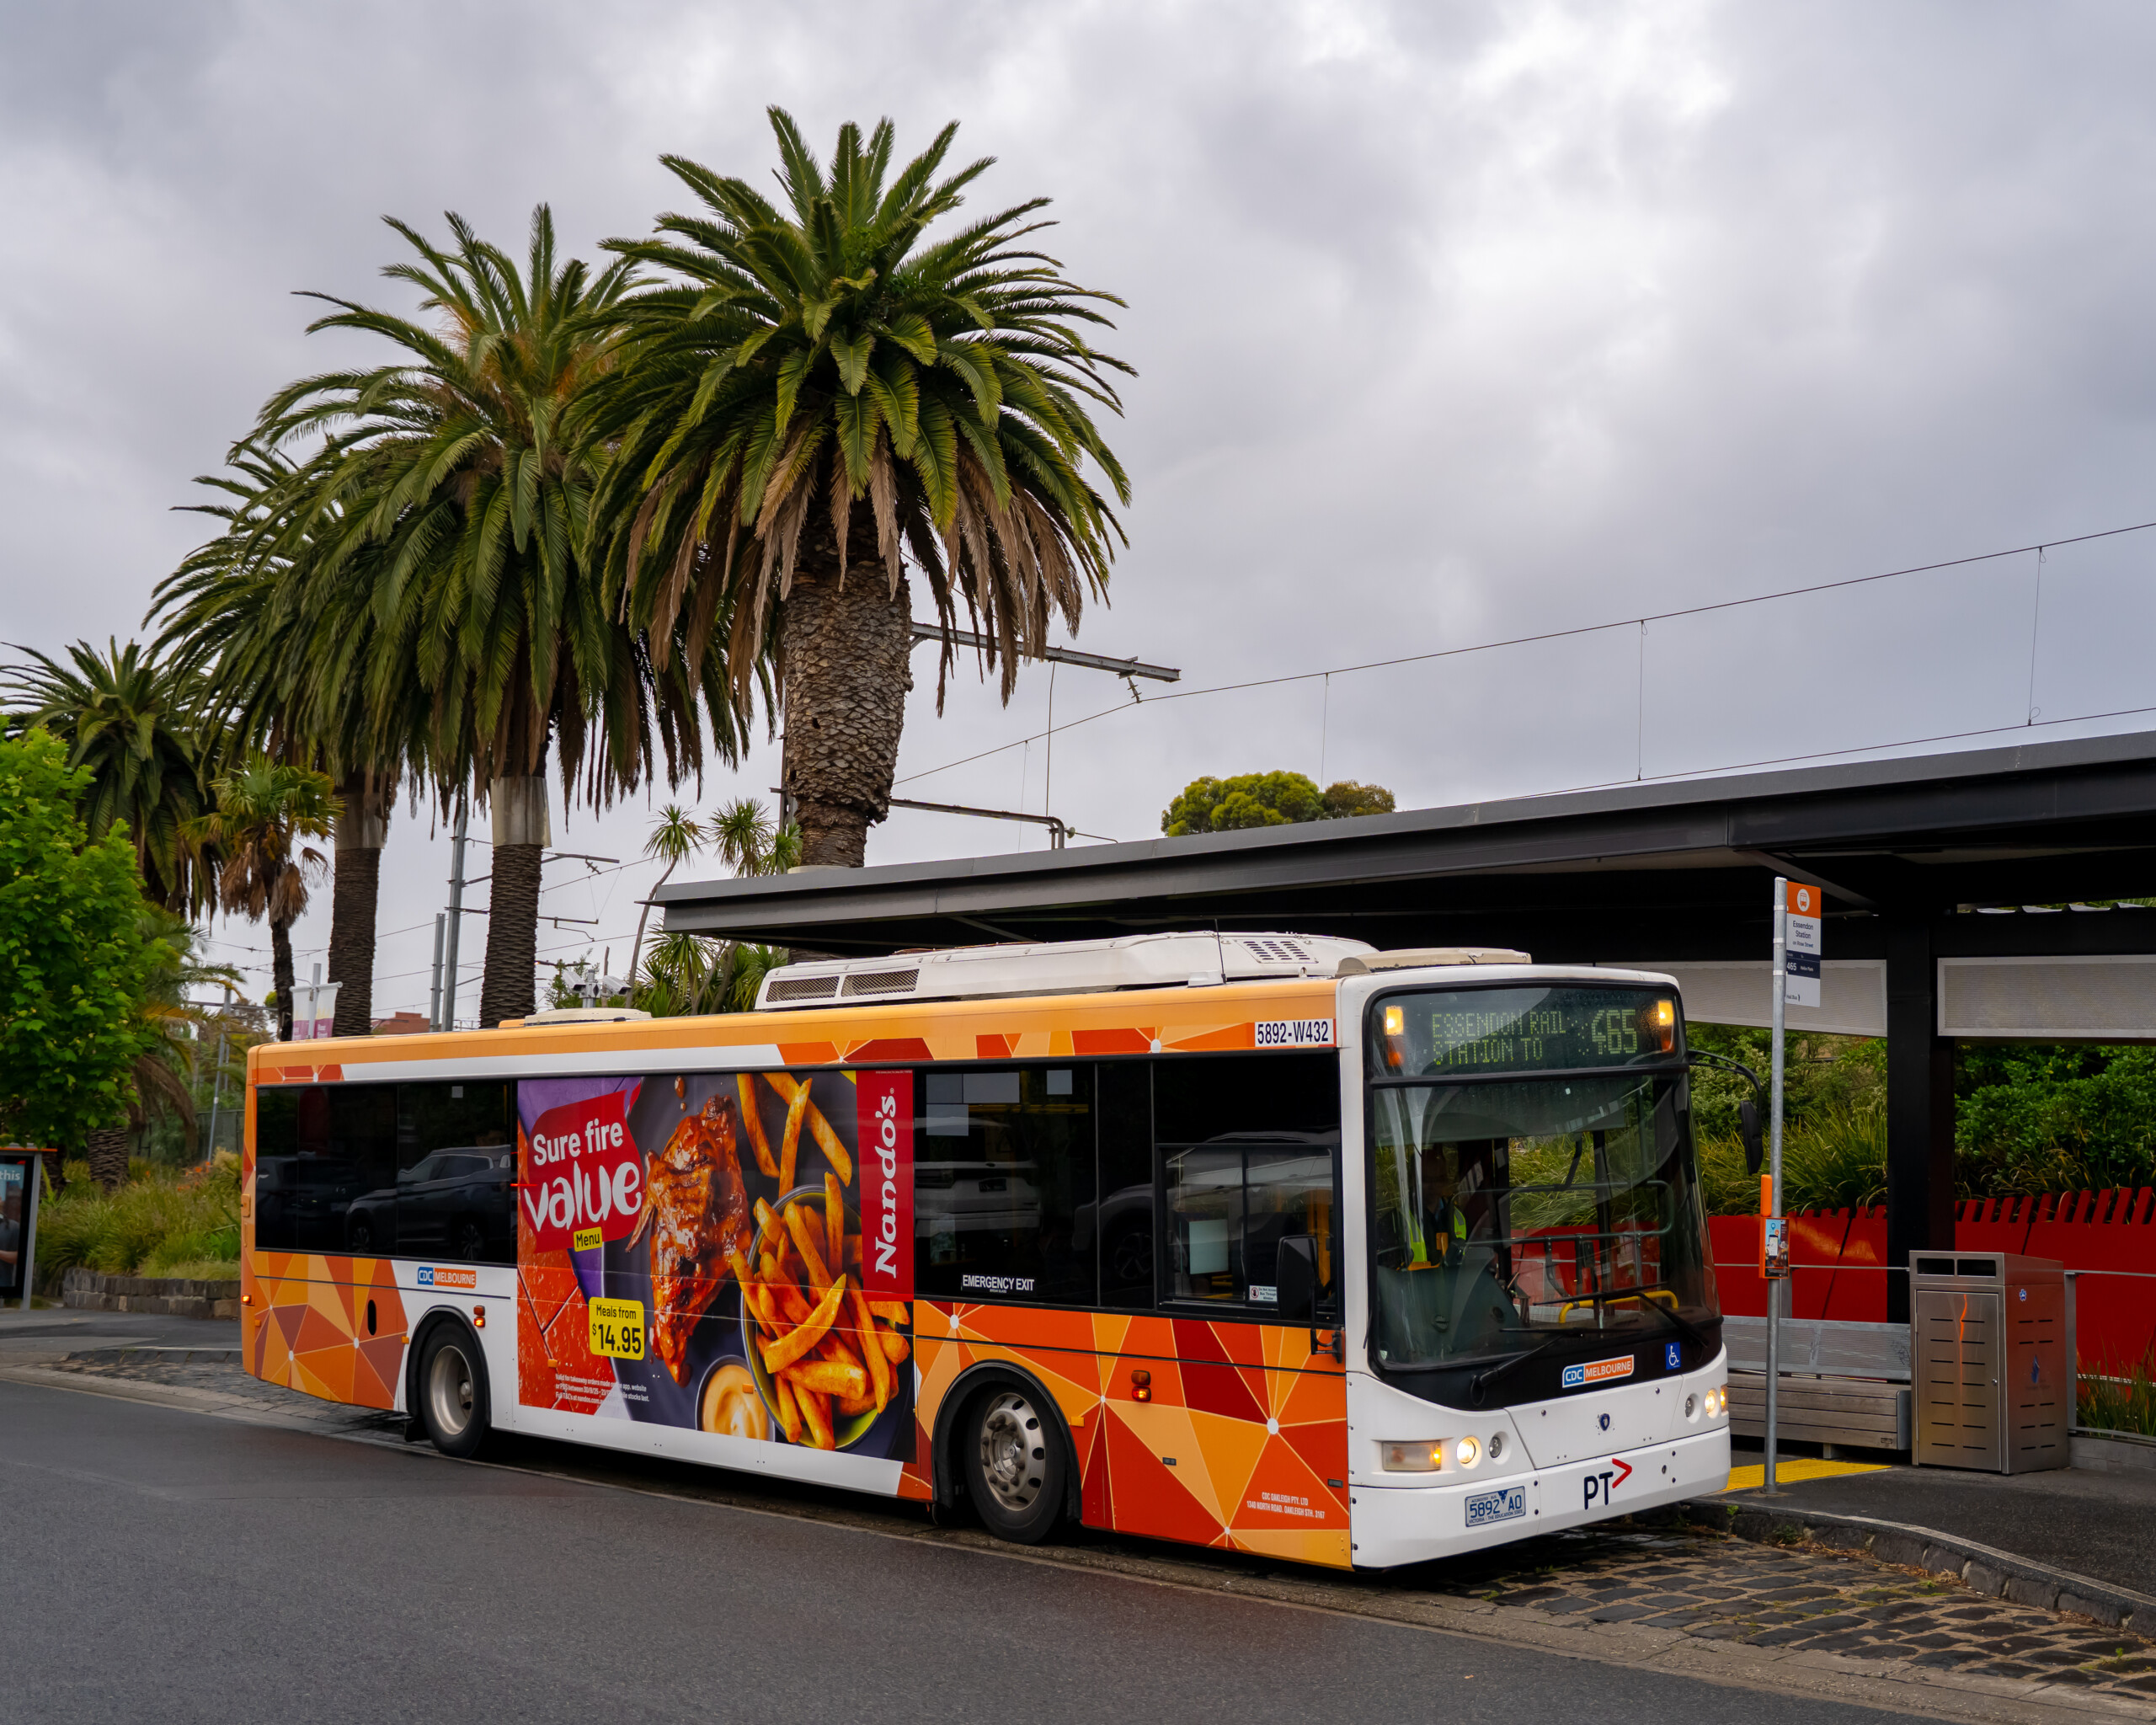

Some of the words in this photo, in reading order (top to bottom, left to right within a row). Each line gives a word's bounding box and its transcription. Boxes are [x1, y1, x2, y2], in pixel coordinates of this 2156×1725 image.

[1792, 920, 1814, 931] Essendon
[1795, 930, 1812, 939] Station
[1786, 962, 1797, 971] 465
[1257, 1020, 1329, 1044] 5892-W432
[1432, 1011, 1523, 1038] ESSENDON
[1529, 1010, 1566, 1035] RAIL
[1590, 1008, 1638, 1055] 465
[1433, 1038, 1514, 1065] STATION
[1520, 1037, 1543, 1062] TO
[533, 1133, 581, 1166] Sure
[584, 1118, 623, 1154] fire
[0, 1169, 21, 1181] this
[524, 1160, 642, 1232] value
[874, 1095, 897, 1279] Nando's
[575, 1233, 600, 1248] Menu
[419, 1269, 433, 1282] CDC
[435, 1271, 476, 1285] MELBOURNE
[963, 1274, 1015, 1290] EMERGENCY
[1016, 1278, 1035, 1291] EXIT
[596, 1304, 617, 1318] Meals
[618, 1306, 637, 1320] from
[592, 1322, 642, 1354] $14.95
[1565, 1368, 1583, 1382] CDC
[1585, 1360, 1631, 1378] MELBOURNE
[1270, 1493, 1291, 1503] OAKLEIGH
[1300, 1497, 1309, 1506] LTD
[1583, 1471, 1614, 1510] PT
[1257, 1501, 1271, 1511] NORTH
[1283, 1505, 1305, 1516] OAKLEIGH
[1470, 1498, 1500, 1519] 5892
